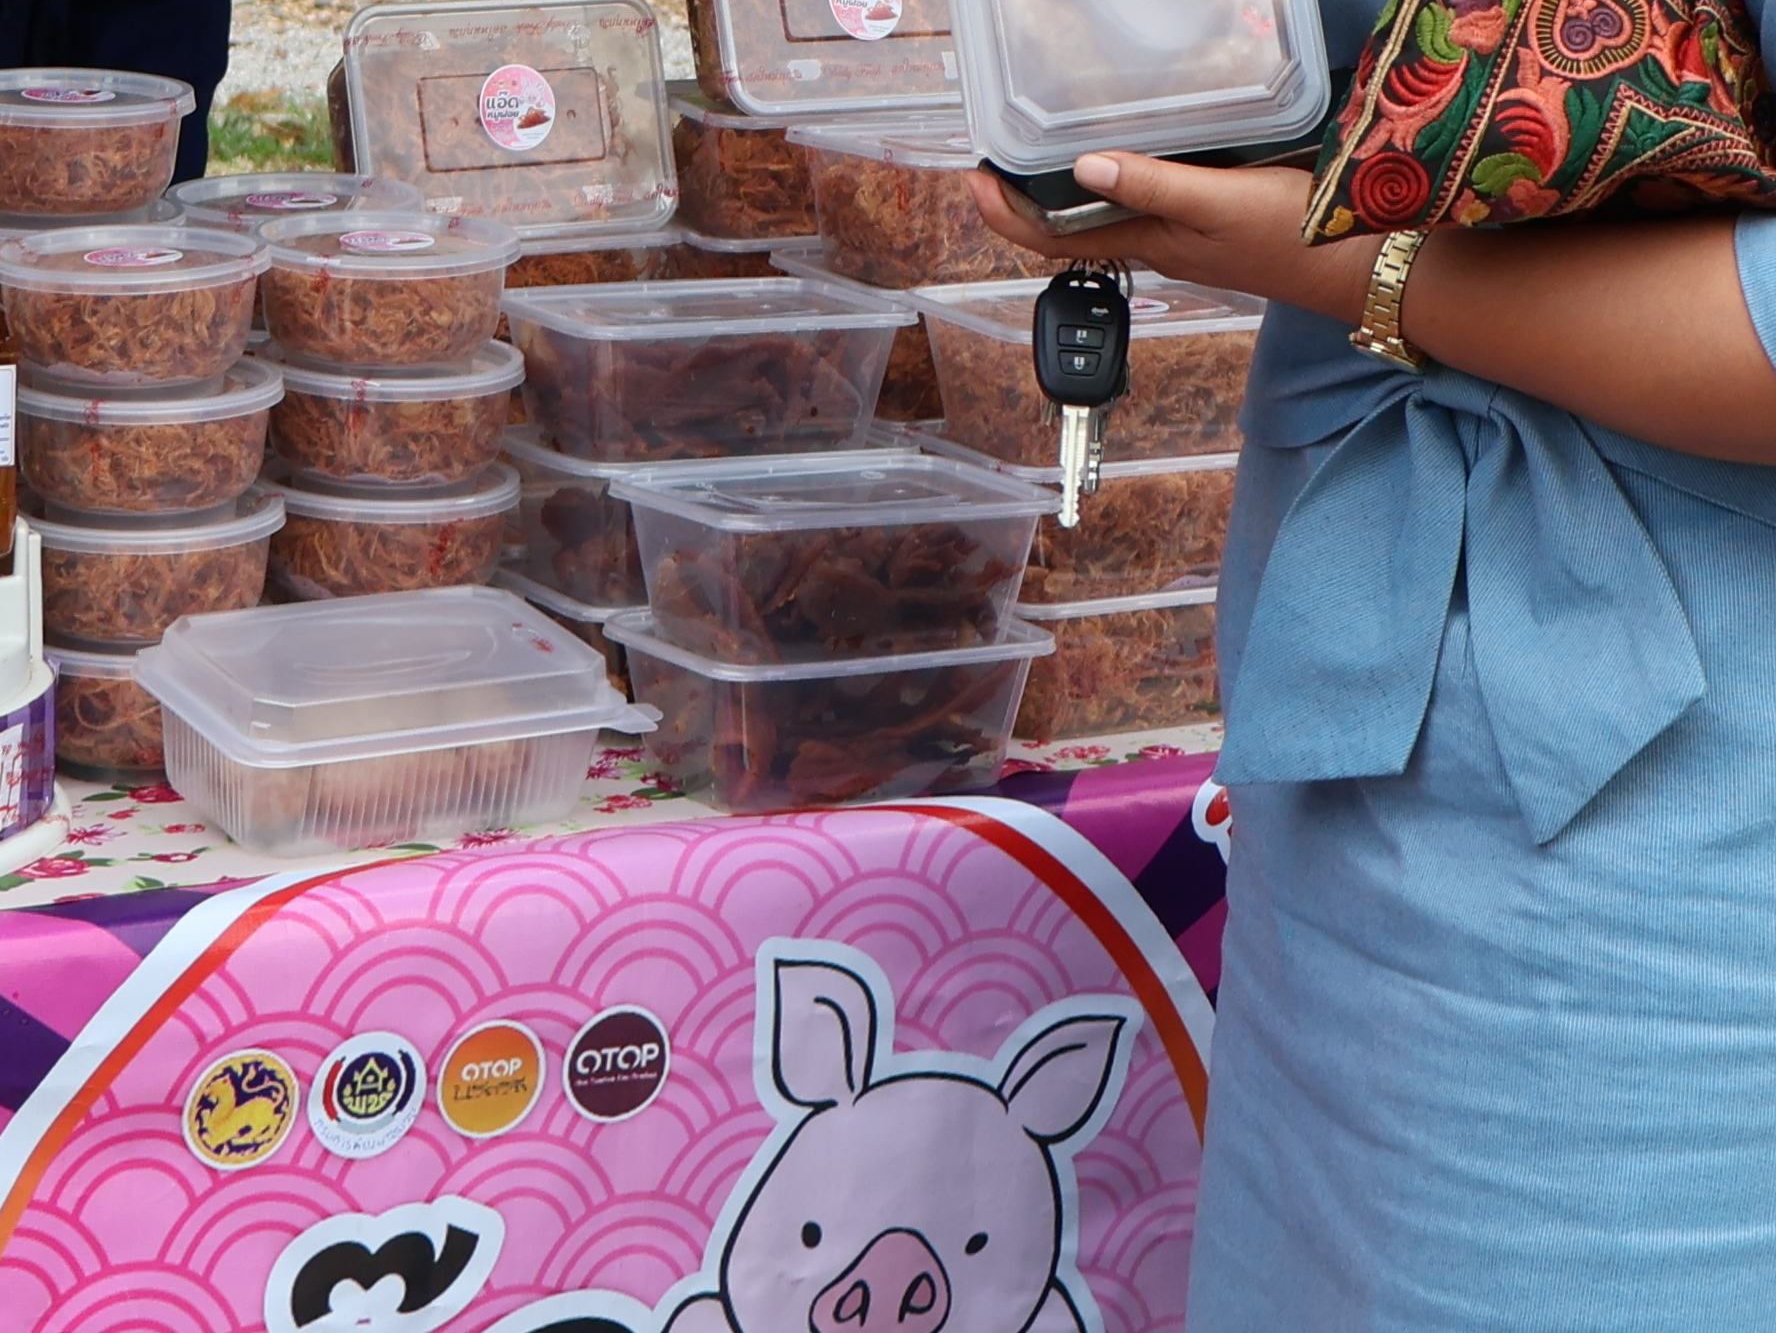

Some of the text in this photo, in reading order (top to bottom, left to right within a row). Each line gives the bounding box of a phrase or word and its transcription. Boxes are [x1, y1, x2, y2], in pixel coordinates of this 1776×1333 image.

[486, 91, 519, 109] แอ๊ด
[461, 1057, 522, 1081] OTOP
[577, 1043, 660, 1075] OTOP
